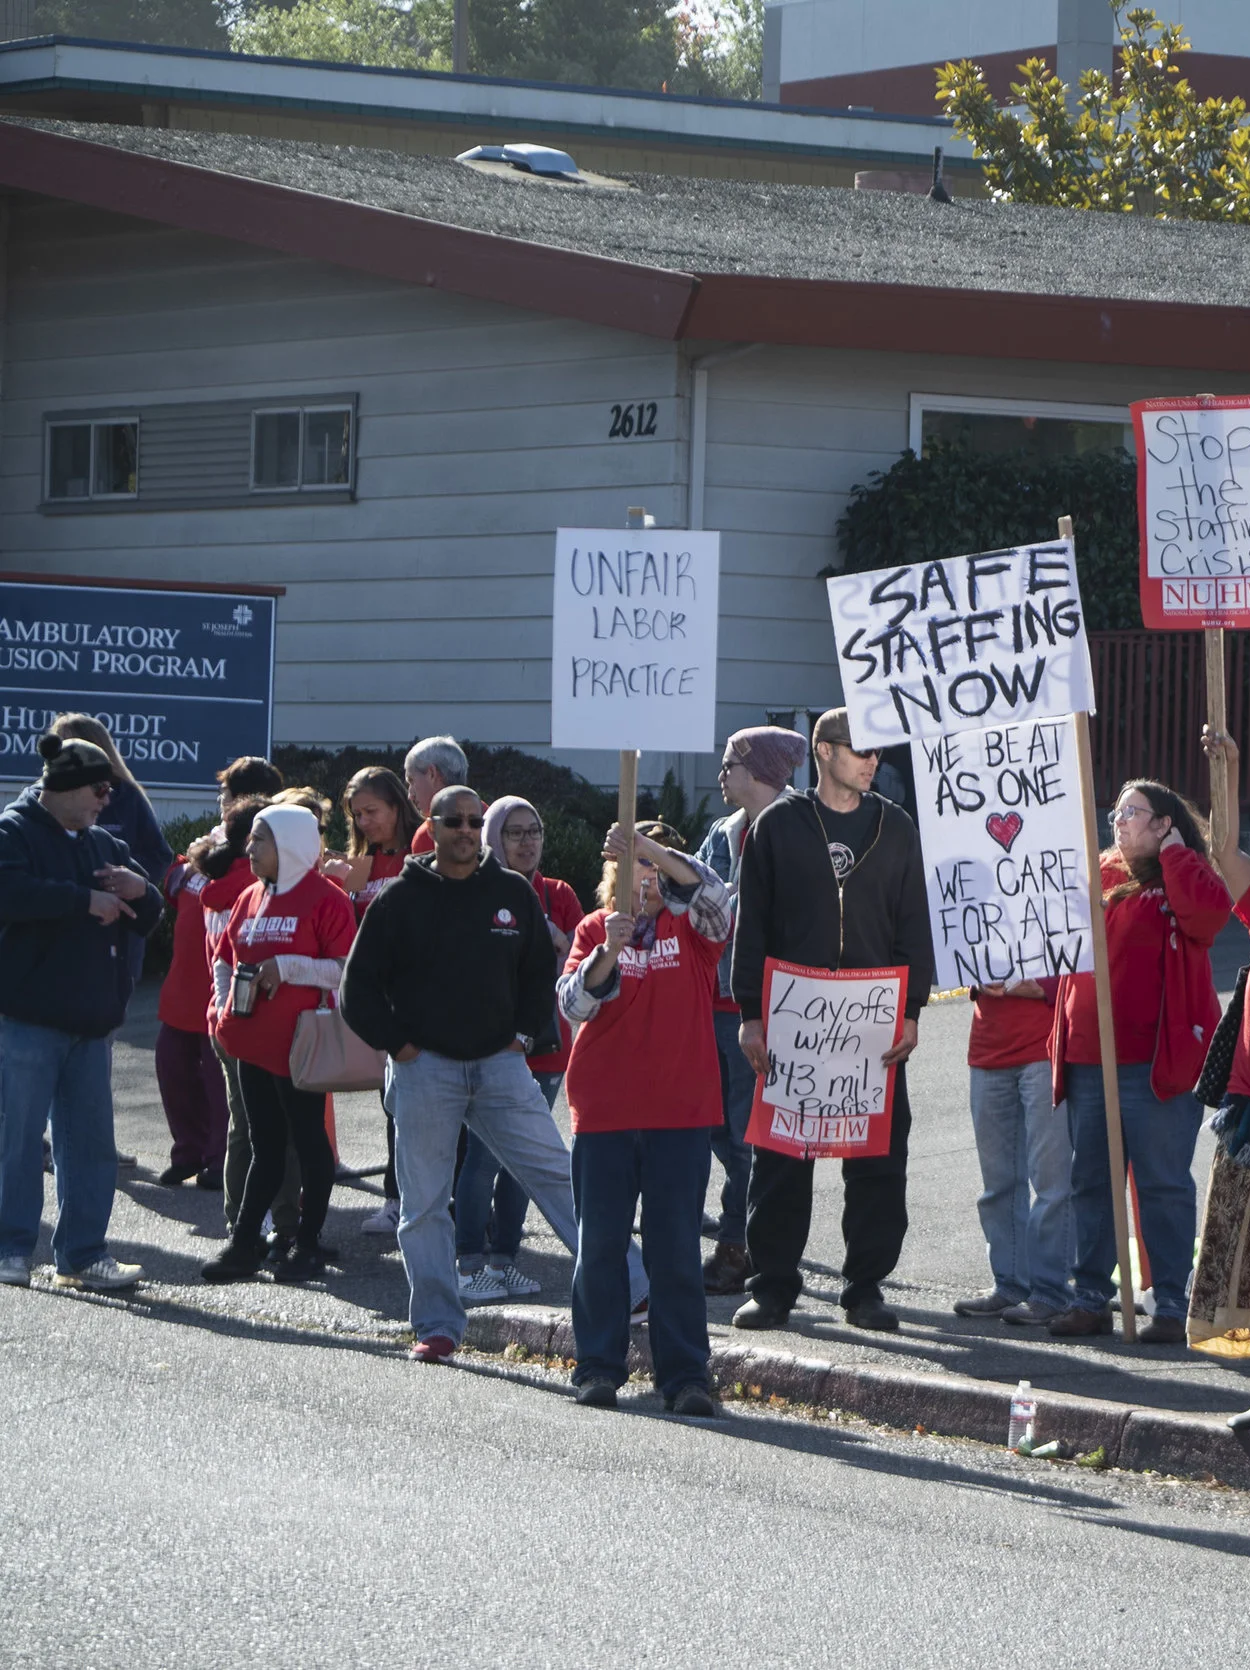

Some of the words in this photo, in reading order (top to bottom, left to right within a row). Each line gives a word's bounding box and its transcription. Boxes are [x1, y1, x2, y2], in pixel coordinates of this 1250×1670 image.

[609, 402, 658, 438] 2612
[1166, 463, 1248, 505] the
[571, 548, 696, 600] UNFAIR
[869, 547, 1071, 627] SAFE
[0, 617, 181, 650] AMBULATORY
[593, 606, 687, 641] LABOR
[841, 594, 1081, 684] STAFFING
[92, 650, 227, 680] PROGRAM
[571, 656, 700, 698] PRACTICE
[888, 655, 1047, 735] NOW
[3, 706, 167, 738] HUOLDT
[921, 732, 964, 773] WE
[985, 722, 1067, 767] BEAT
[935, 771, 986, 816] AS
[997, 763, 1066, 807] ONE
[935, 861, 976, 905] WE
[996, 848, 1079, 896] CARE
[939, 902, 1007, 947] FOR
[1020, 894, 1089, 939] ALL
[954, 935, 1083, 986] NUHW
[772, 978, 896, 1040] Layoffs
[795, 1022, 861, 1055] with
[765, 1049, 816, 1097] $43
[828, 1058, 868, 1097] mil
[774, 1111, 868, 1139] NUHW
